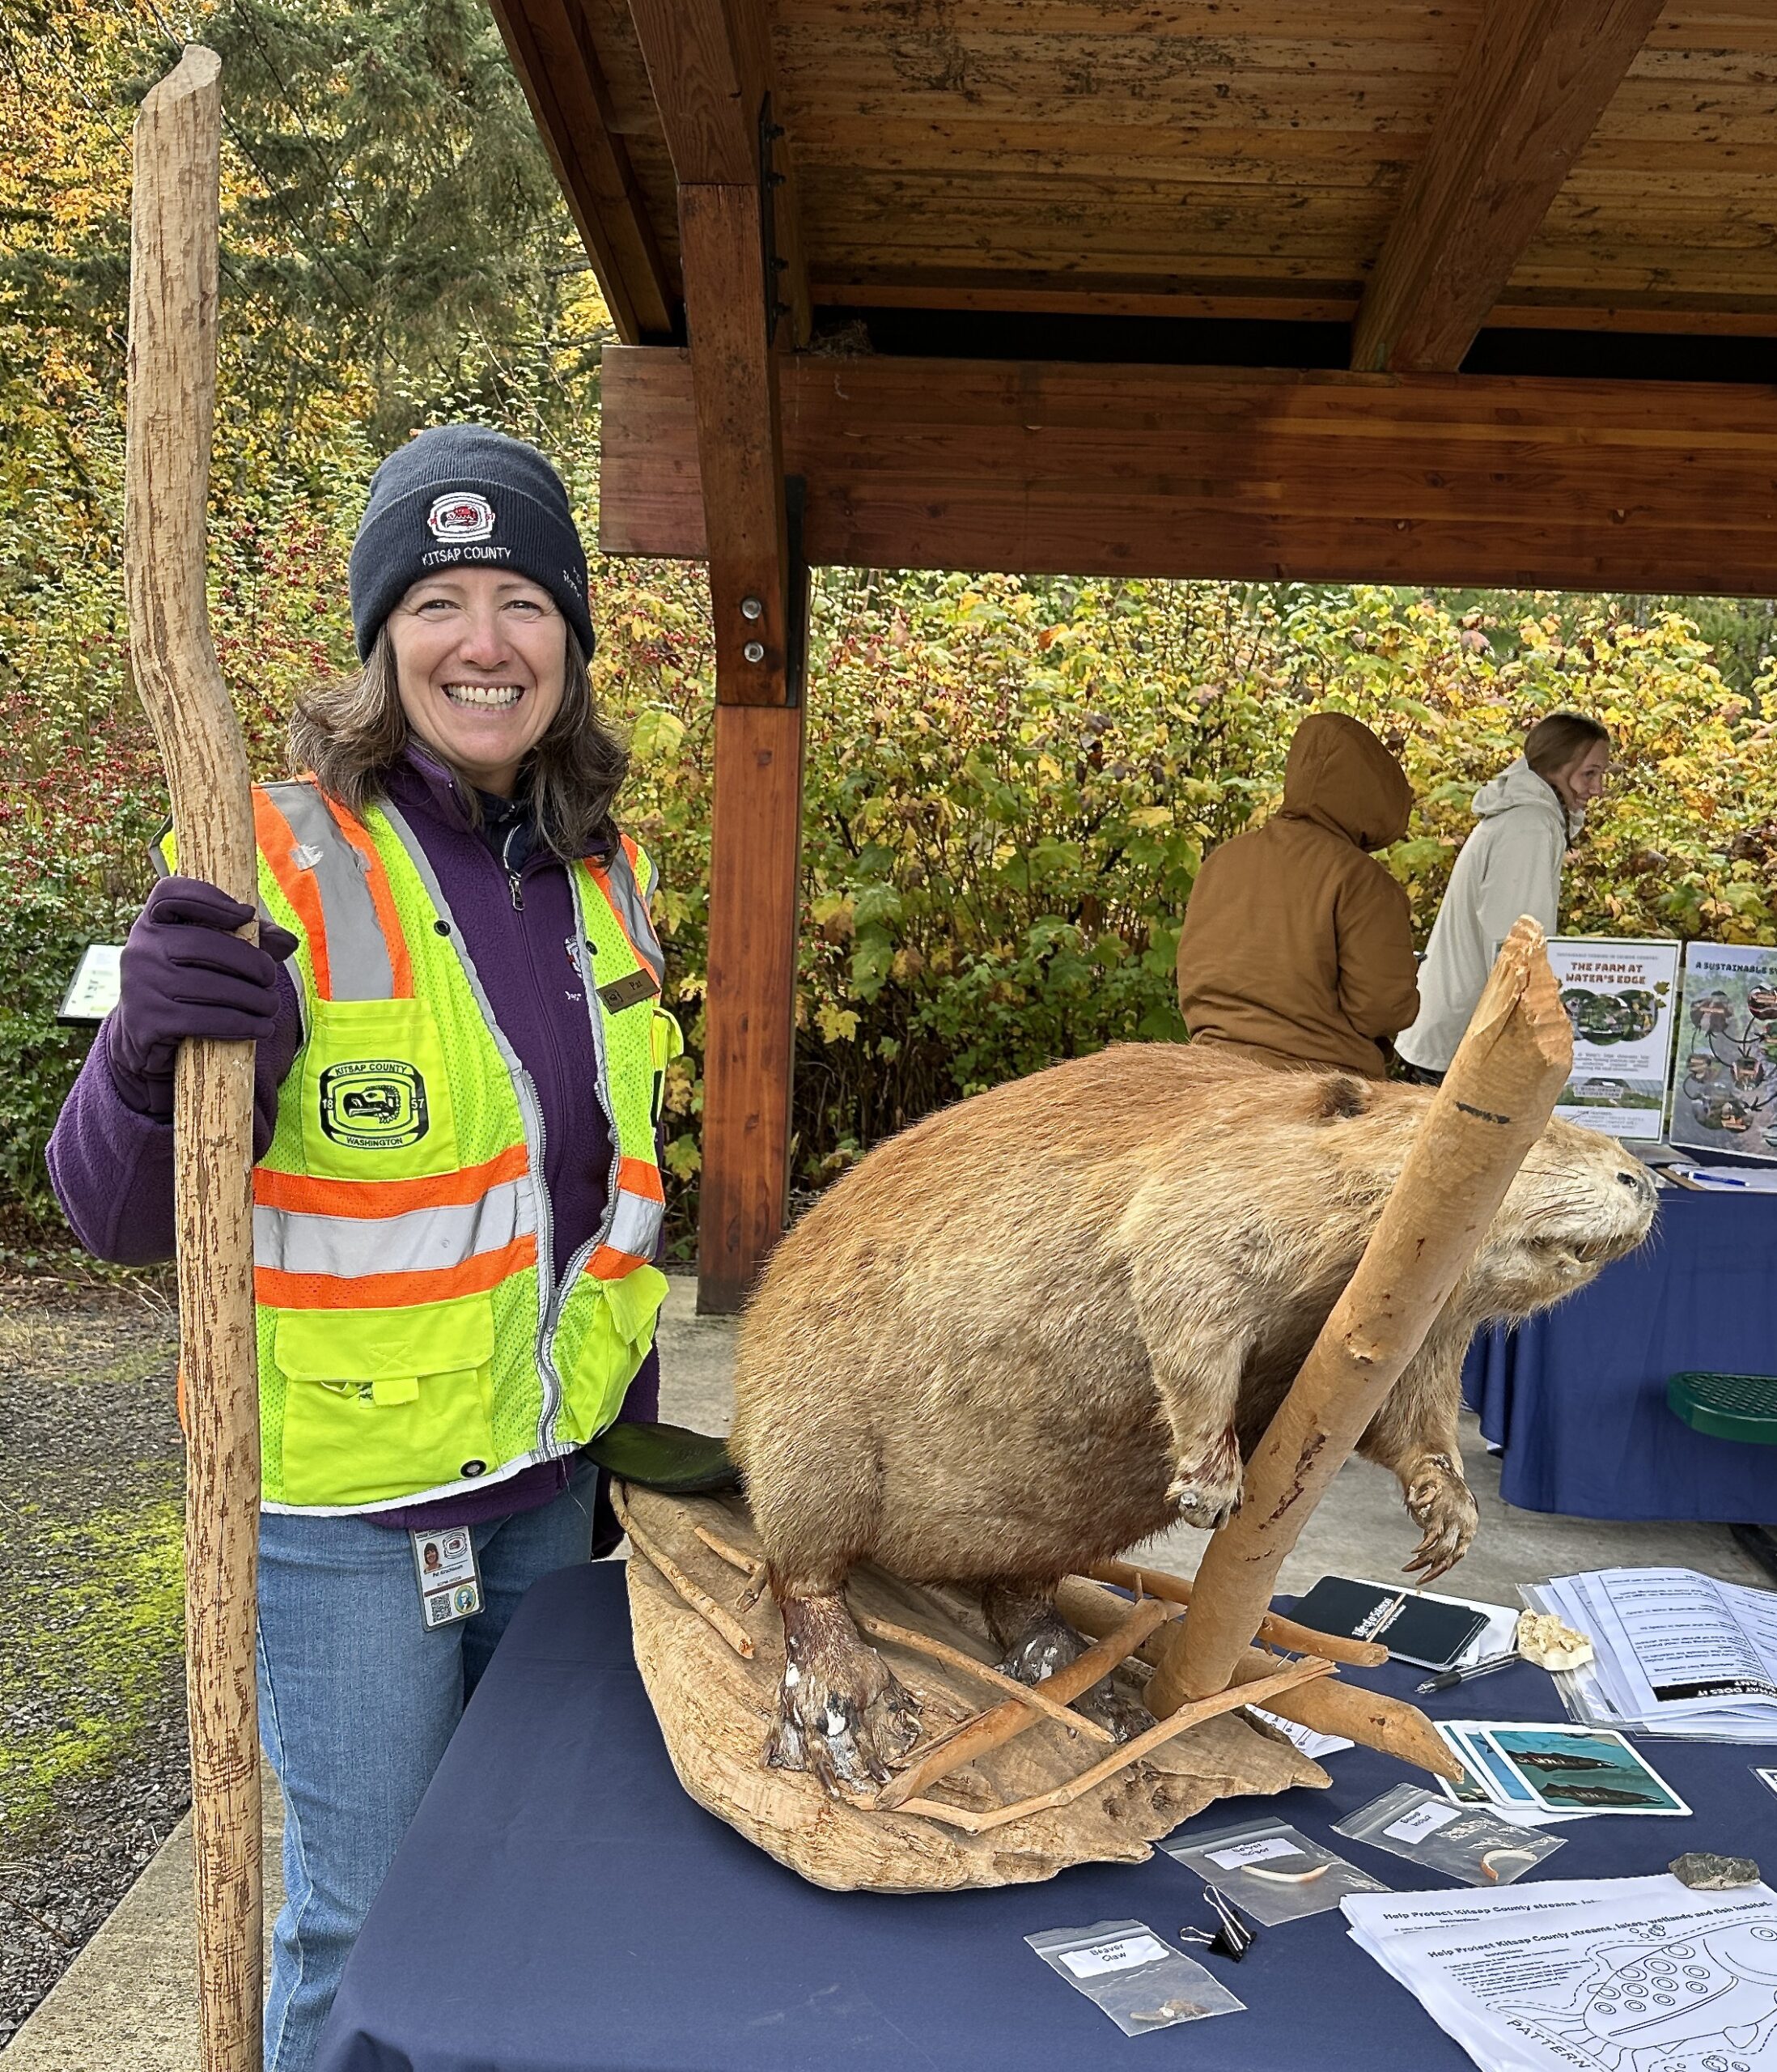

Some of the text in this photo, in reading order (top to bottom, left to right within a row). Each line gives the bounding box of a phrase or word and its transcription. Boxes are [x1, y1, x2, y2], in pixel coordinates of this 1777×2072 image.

[422, 546, 511, 566] KITSAP COUNTY
[1571, 962, 1643, 973] THE FARM AT
[1703, 962, 1767, 974] SUSTAINABLE
[1566, 973, 1646, 985] WATER'S EDGE
[335, 1064, 407, 1076] KITSAP COUNTY
[322, 1098, 333, 1110] 18
[411, 1098, 425, 1109] 57
[346, 1136, 403, 1147] WASHINGTON
[1709, 1686, 1743, 1695] DOES
[1427, 1949, 1454, 1958] Help
[1454, 1942, 1496, 1953] Protect
[1495, 1938, 1531, 1947] Kitsap
[1532, 1931, 1568, 1942] County
[1571, 1926, 1617, 1936] streams,
[1615, 1921, 1648, 1930] lakes,
[1648, 1913, 1694, 1924] wetlands
[1694, 1909, 1714, 1917] and
[1732, 1901, 1773, 1911] habitat.
[1089, 1943, 1124, 1955] Beaver
[1102, 1951, 1126, 1962] Claw
[1506, 2019, 1591, 2068] PATTERN
